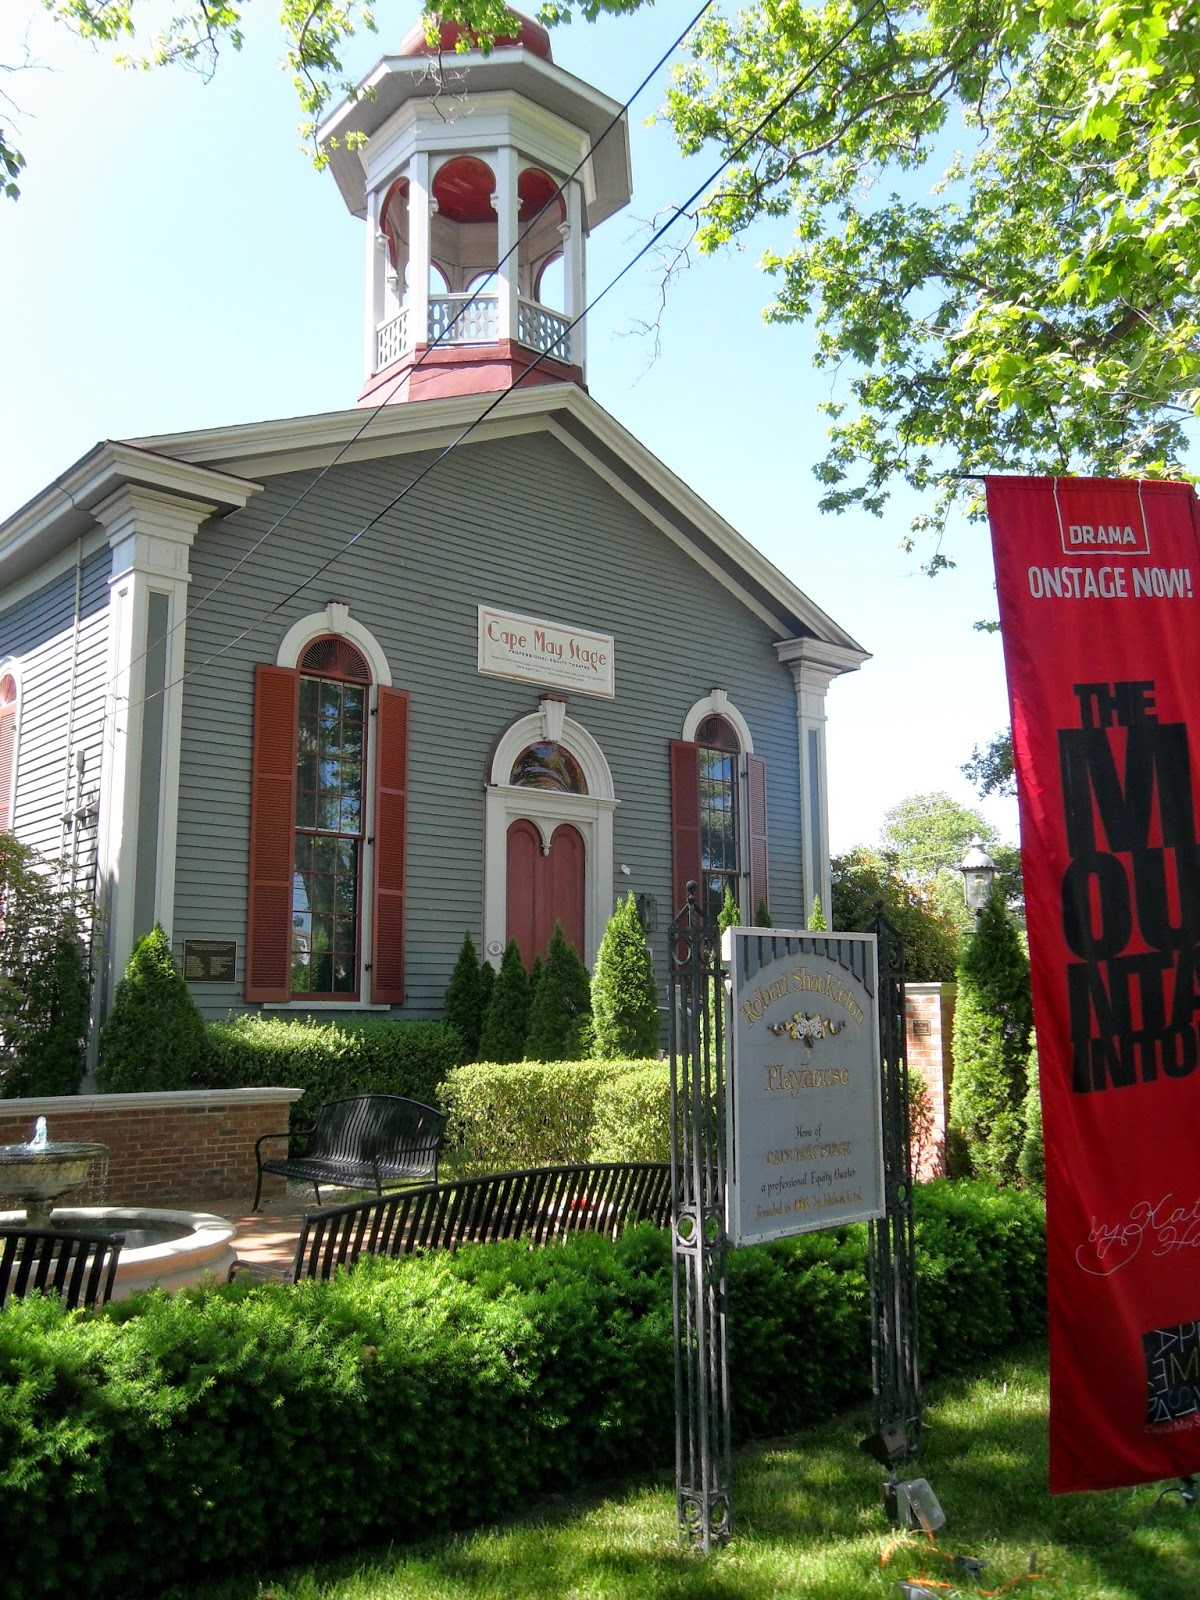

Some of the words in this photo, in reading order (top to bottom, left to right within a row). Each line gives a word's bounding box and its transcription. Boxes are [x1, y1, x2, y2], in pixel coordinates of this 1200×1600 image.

[1068, 525, 1137, 545] DRAMA
[1027, 565, 1128, 599] ONSTAGE
[1132, 567, 1194, 599] NOW!
[487, 620, 527, 650] Cape
[533, 629, 563, 660] May
[569, 638, 607, 674] Stage
[508, 649, 549, 663] PROFESSIONAL
[549, 656, 568, 667] EQUITY
[568, 661, 591, 672] THEATRE
[1073, 681, 1159, 729] THE
[739, 969, 792, 1029] Robert
[1072, 1022, 1200, 1094] INTO
[764, 1062, 849, 1098] Playhouse
[795, 1126, 812, 1139] Home
[815, 1123, 822, 1141] of
[767, 1173, 808, 1198] professional
[811, 1171, 832, 1187] Equity
[834, 1167, 856, 1180] theater
